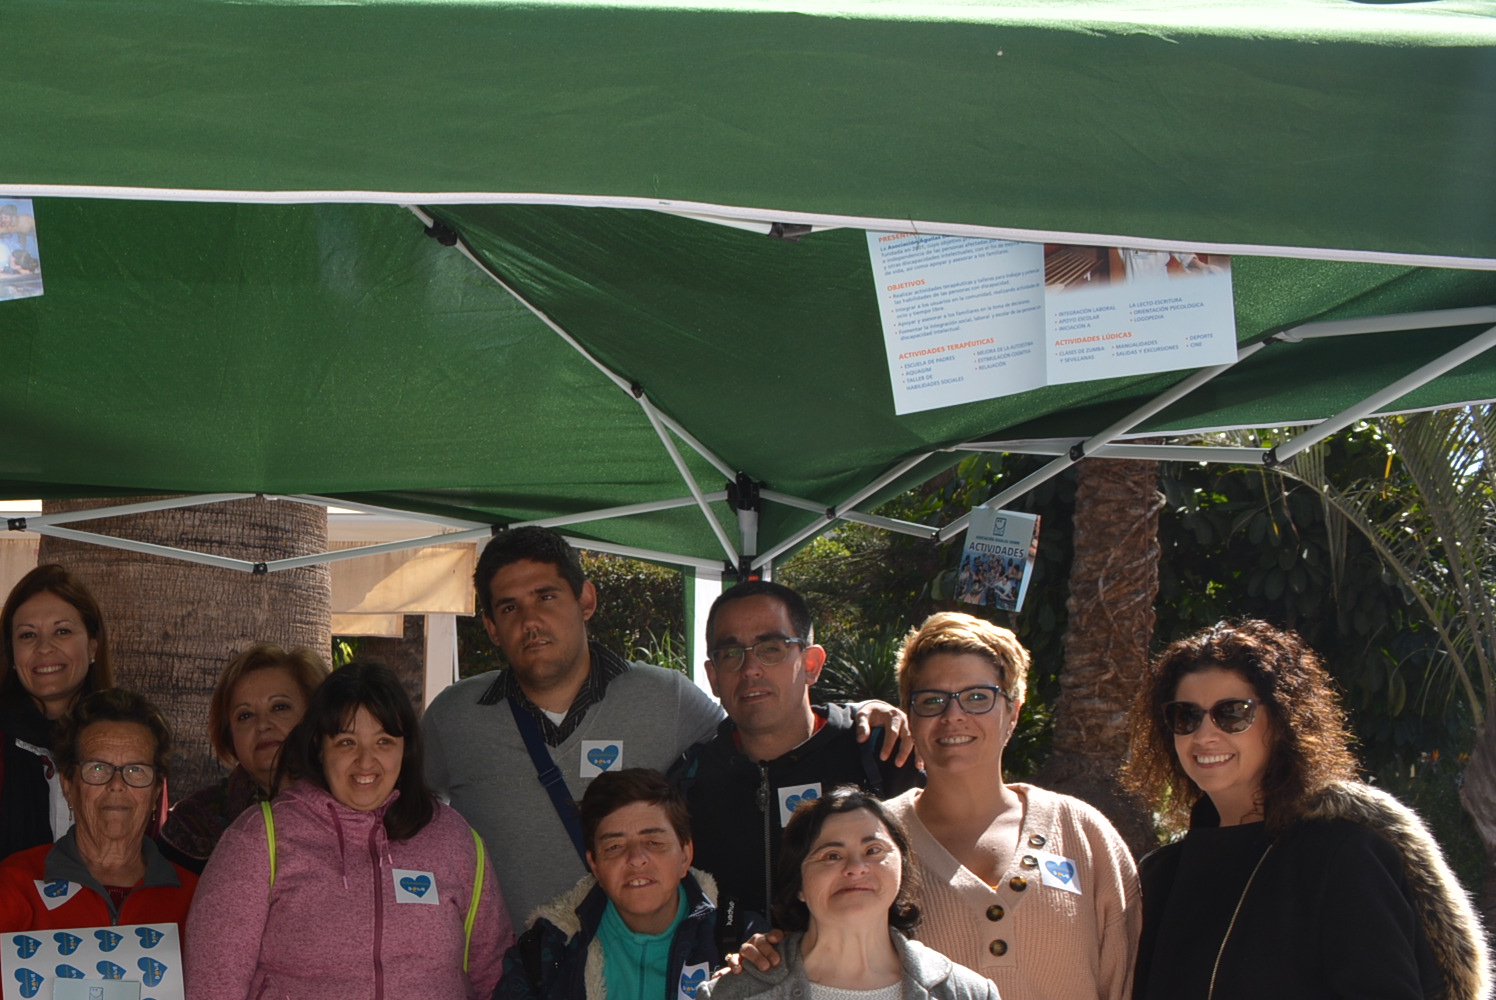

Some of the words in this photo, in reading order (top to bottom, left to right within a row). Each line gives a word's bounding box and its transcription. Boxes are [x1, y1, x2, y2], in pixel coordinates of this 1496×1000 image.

[887, 279, 925, 291] OBJETIVOS
[1054, 335, 1100, 346] ACTIVIDADES
[1102, 331, 1132, 340] LÚDICAS
[898, 346, 945, 360] ACTIVIDADES
[969, 541, 1025, 558] ACTIVIDADES
